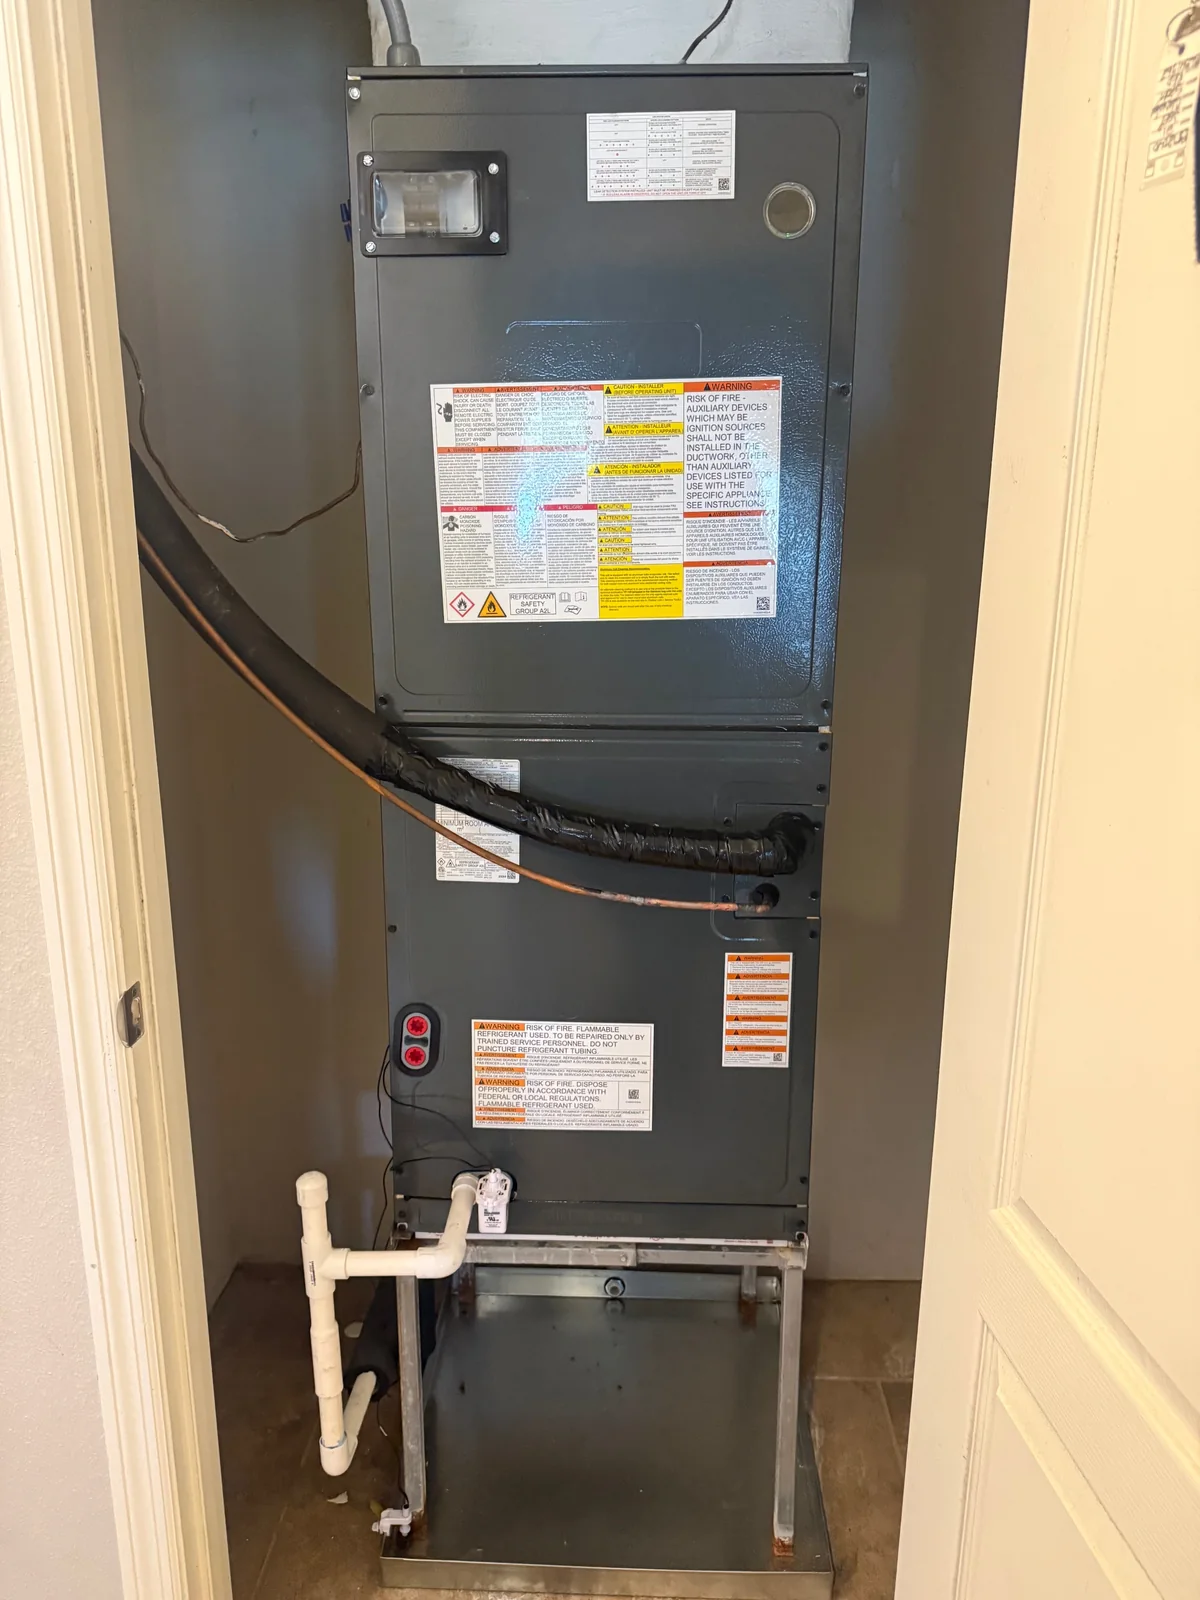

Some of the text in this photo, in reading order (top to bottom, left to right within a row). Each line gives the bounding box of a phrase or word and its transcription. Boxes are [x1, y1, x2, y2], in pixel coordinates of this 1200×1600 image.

[687, 403, 767, 412] AUXILIARY DEVICES
[687, 423, 766, 432] IGNITION SOURCES
[687, 444, 731, 452] INSTALLED
[687, 453, 737, 461] DUCTWORK,
[710, 462, 752, 470] AUXILIARY
[687, 472, 722, 480] DEVICES
